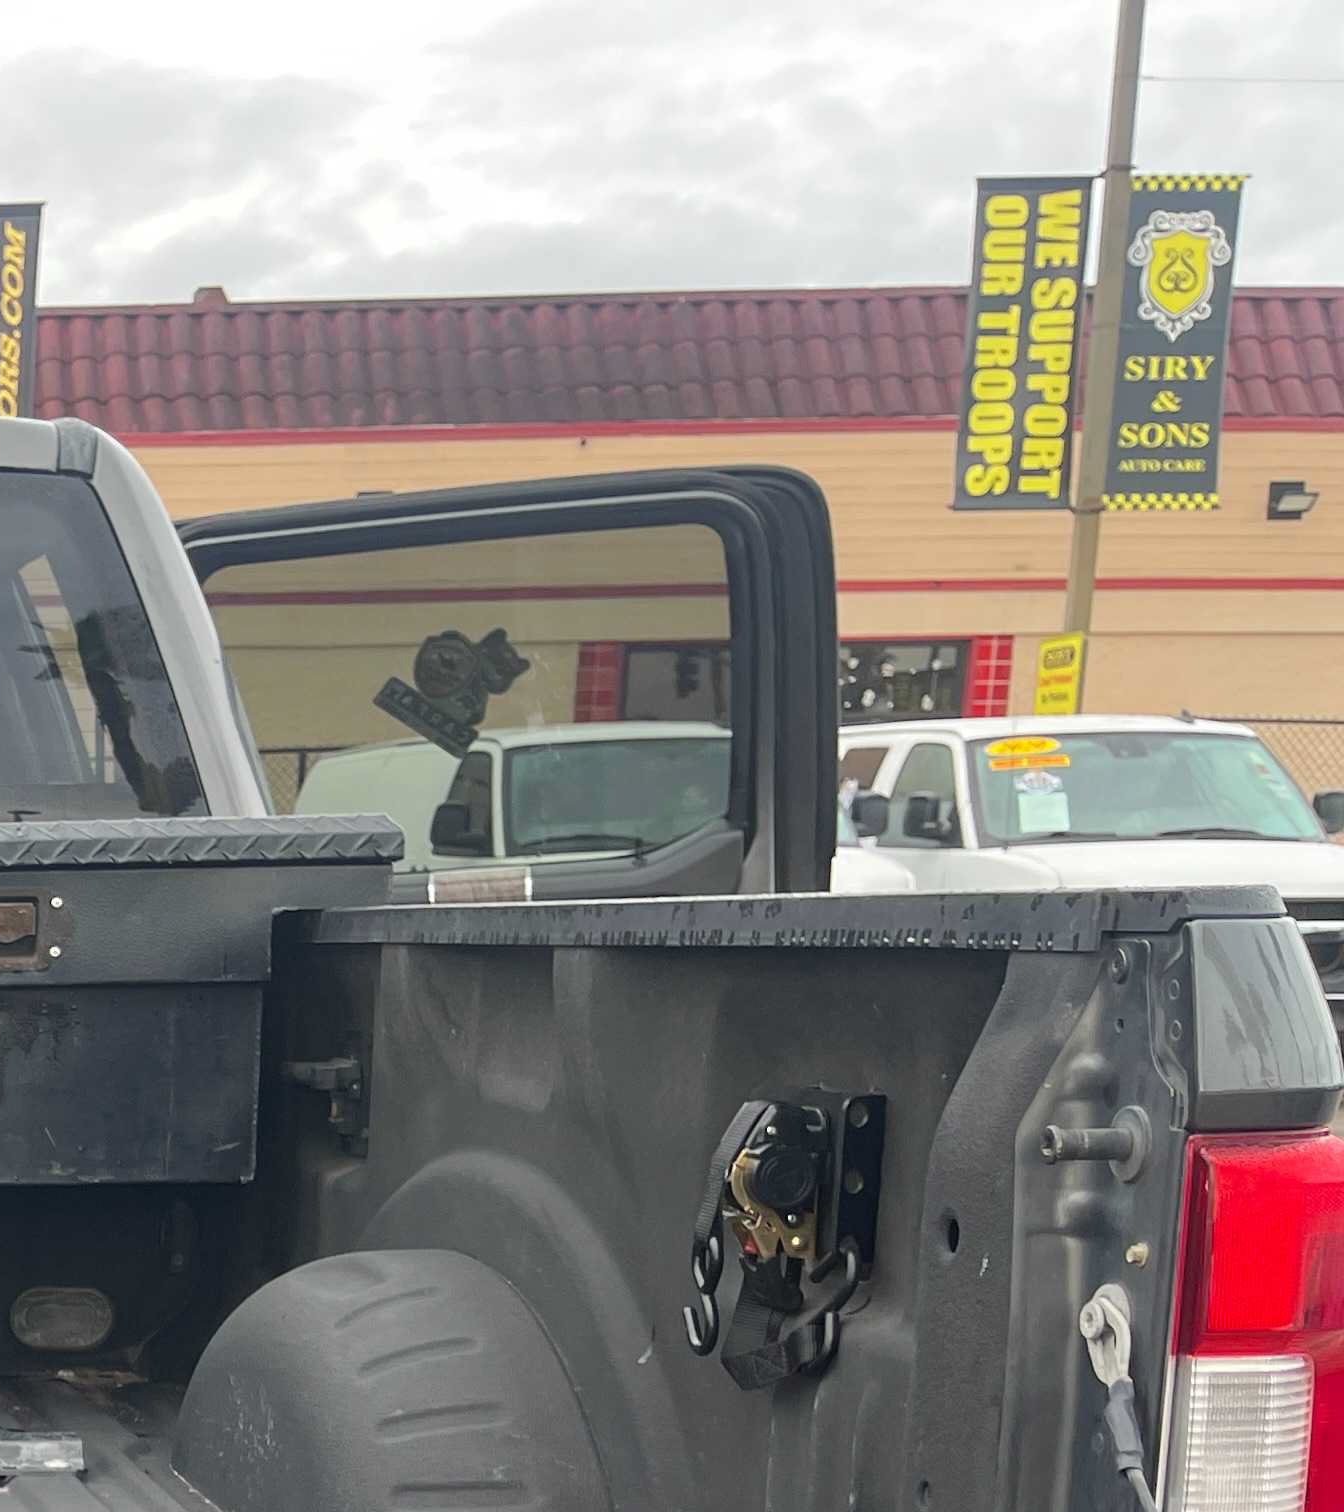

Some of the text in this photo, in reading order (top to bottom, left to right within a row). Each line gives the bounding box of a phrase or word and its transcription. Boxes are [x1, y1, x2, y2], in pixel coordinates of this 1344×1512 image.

[964, 194, 1030, 496] OUR TROOPS
[1018, 189, 1083, 498] WE SUPPORT
[1123, 355, 1214, 382] SIRY
[1150, 390, 1182, 413] &
[1117, 422, 1210, 449] SONS
[1118, 458, 1207, 473] AUTO CARE
